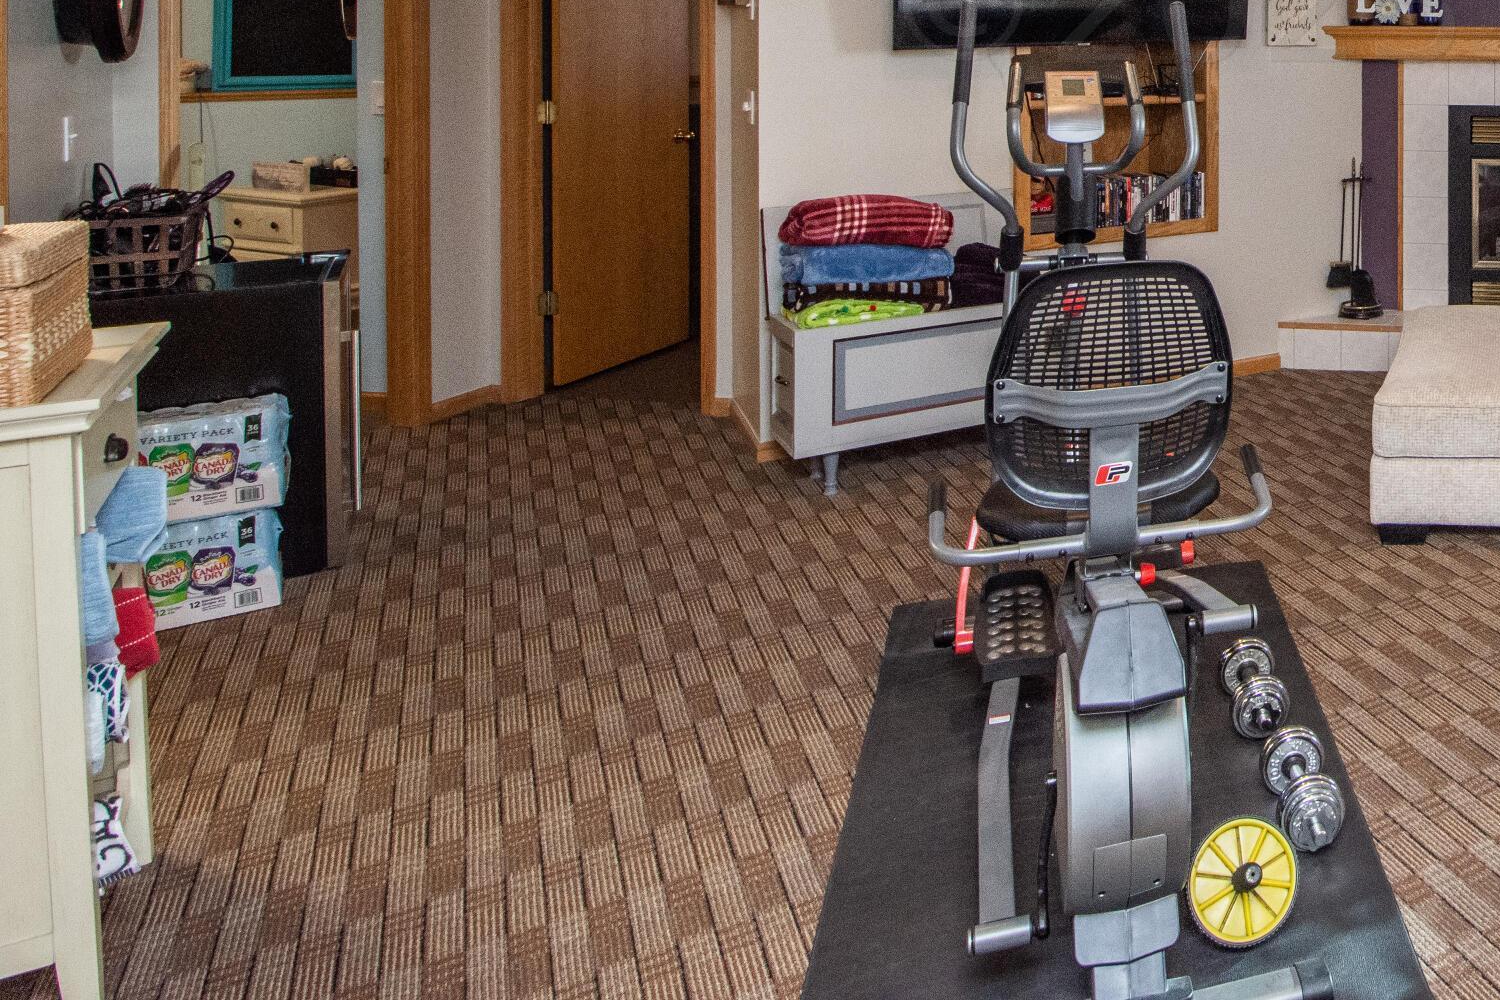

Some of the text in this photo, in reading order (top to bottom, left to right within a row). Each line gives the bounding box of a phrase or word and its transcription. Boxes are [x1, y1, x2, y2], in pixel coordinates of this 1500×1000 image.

[246, 424, 259, 432] 36
[140, 427, 234, 445] VARIETY PACK
[193, 457, 234, 474] CANADA
[206, 467, 226, 477] DRY
[190, 494, 202, 502] 12
[240, 526, 253, 536] 36
[162, 539, 193, 550] IETY
[198, 531, 229, 542] PACK
[147, 566, 186, 586] CANADA
[191, 562, 231, 580] CANADA
[203, 569, 225, 582] DRY
[161, 575, 181, 588] DRY
[189, 600, 201, 609] 12
[155, 609, 166, 617] 12
